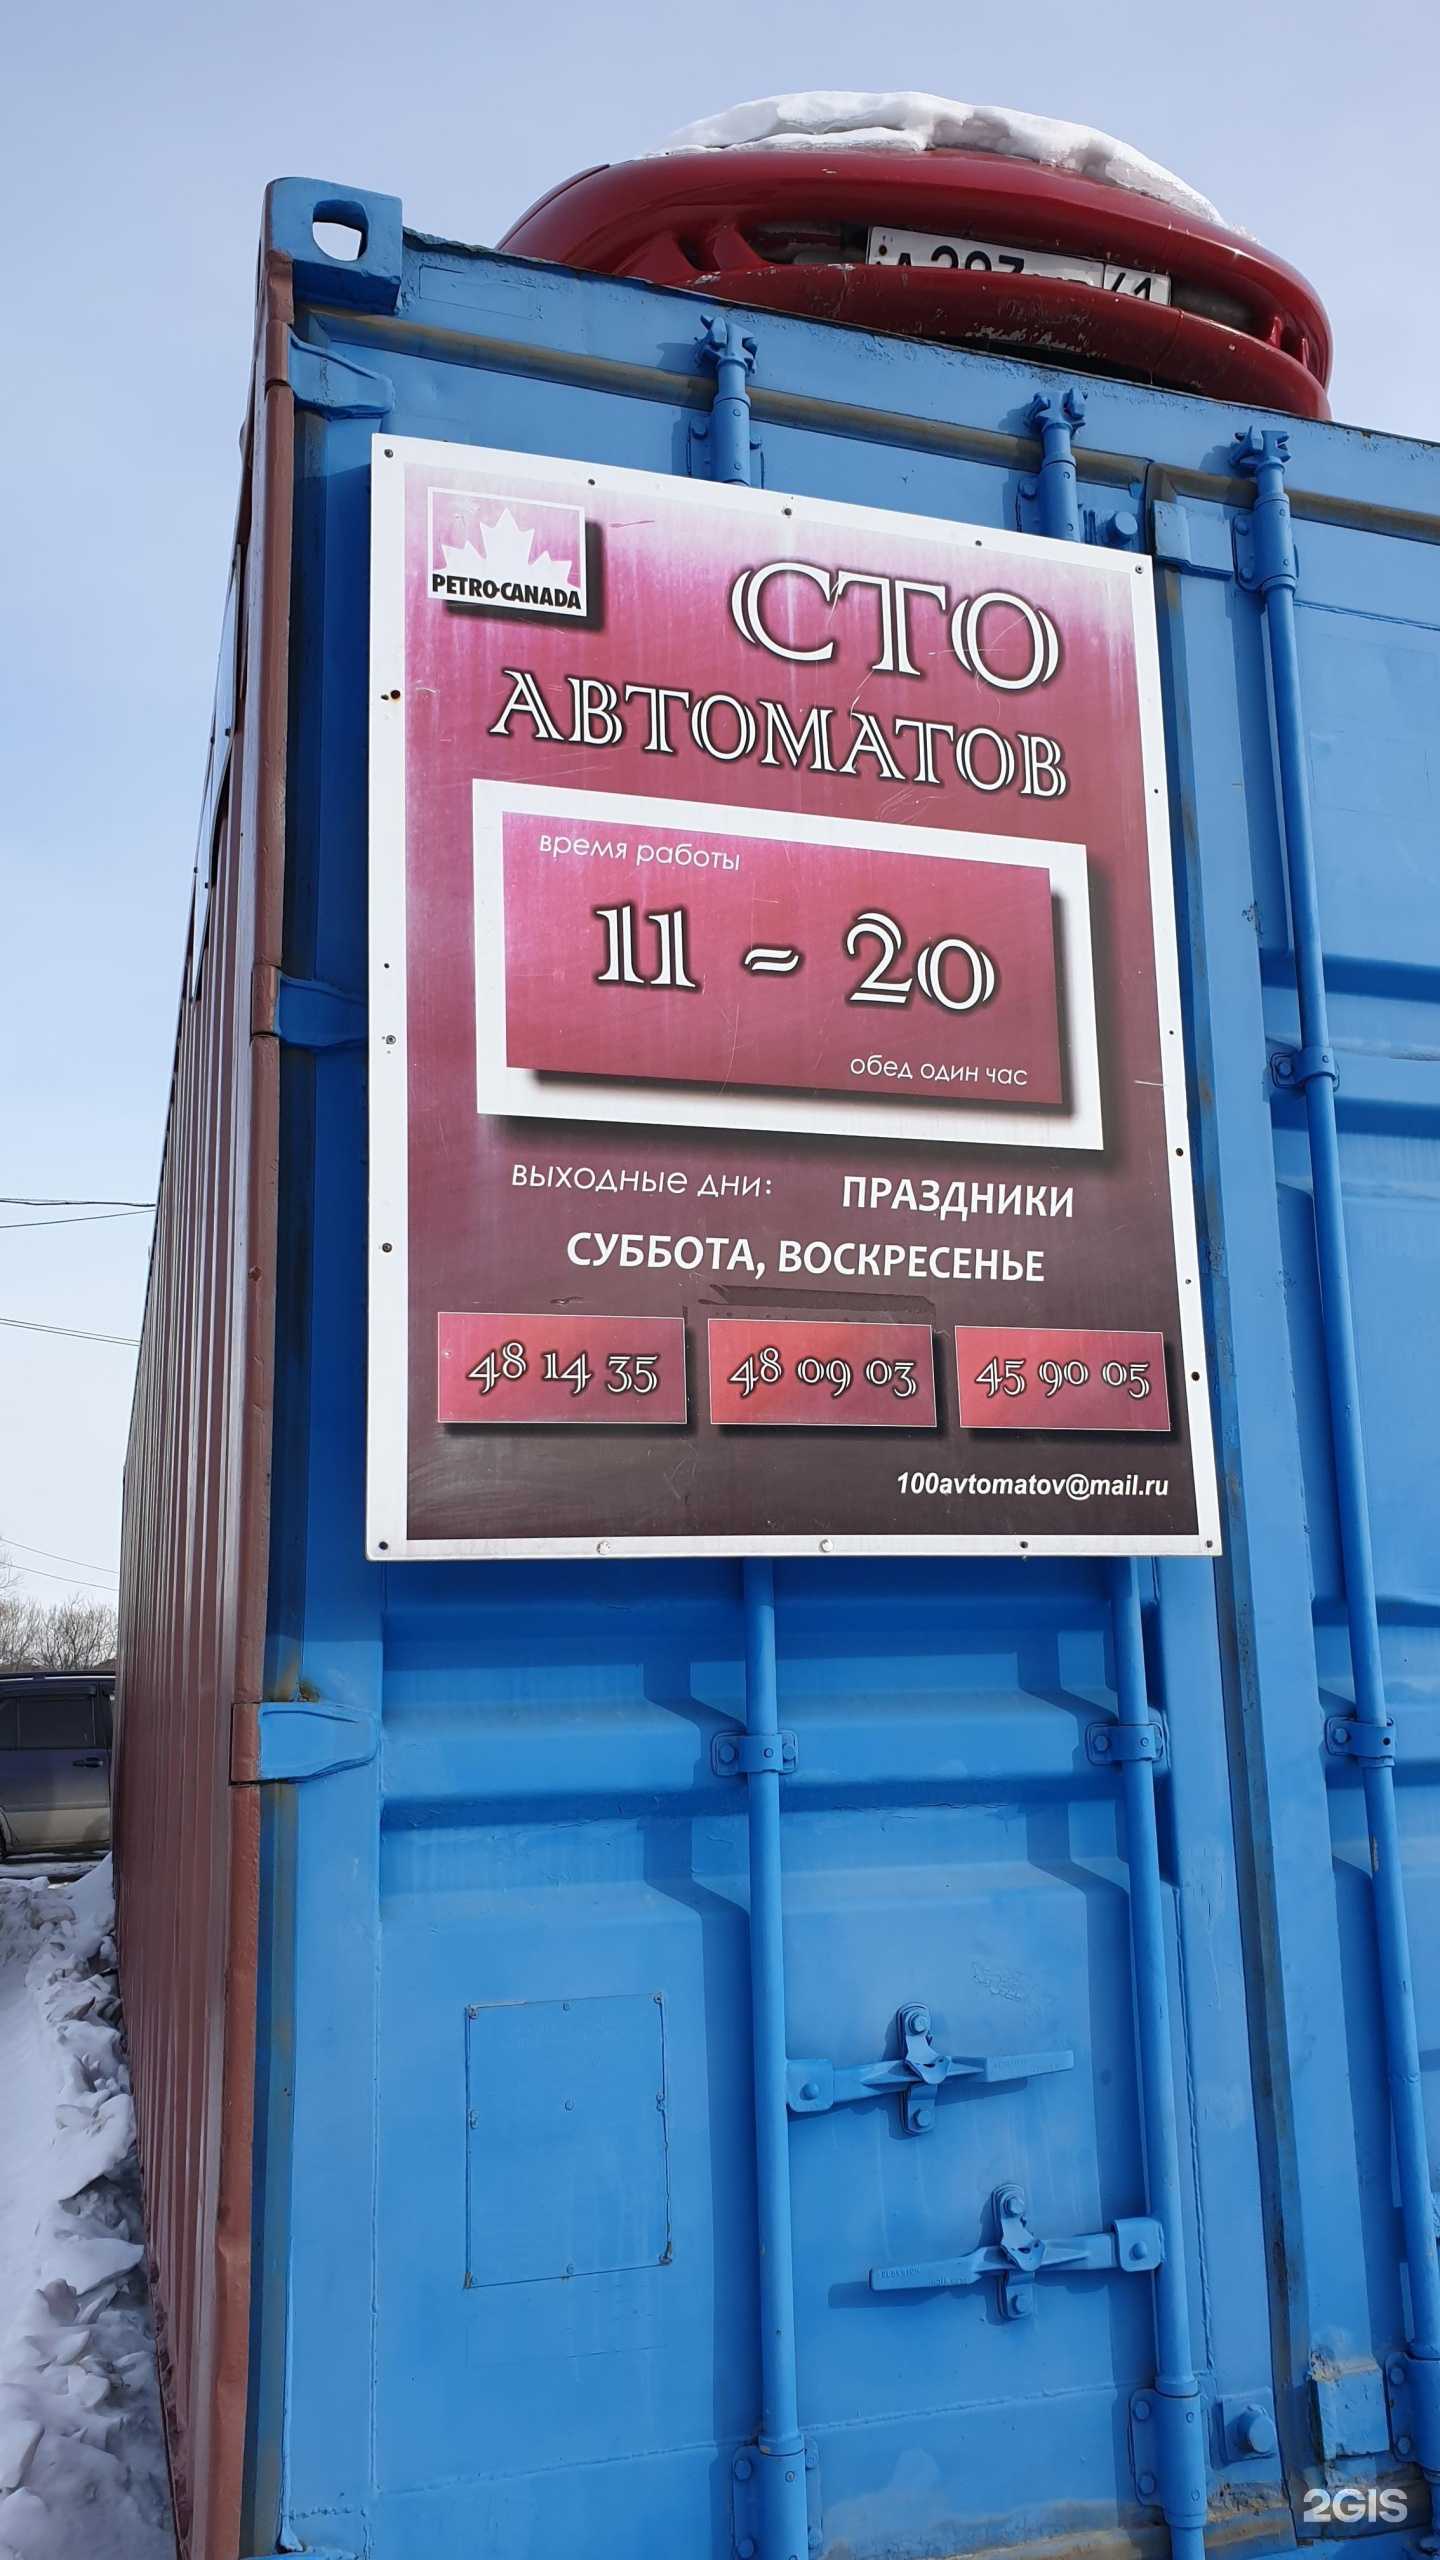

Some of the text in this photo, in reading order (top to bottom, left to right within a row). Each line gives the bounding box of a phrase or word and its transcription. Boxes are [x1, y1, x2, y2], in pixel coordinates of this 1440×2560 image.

[730, 561, 1062, 691] СТО
[489, 669, 1067, 799] АВТОМАТОВ
[539, 834, 740, 871] время работы
[594, 905, 697, 989] 11
[845, 912, 996, 1011] 20
[850, 1054, 1029, 1086] обед один час
[511, 1163, 1075, 1222] выходные дни: ПРАЗДНИКИ
[566, 1232, 1045, 1282] СУББОТА, ВОСКРЕСЕНЬЕ
[467, 1341, 659, 1395] 48 14 35
[728, 1346, 918, 1398] 48 09 03
[975, 1357, 1151, 1399] 45 90 05
[897, 1471, 1170, 1501] 100avtomatov@mail.ru
